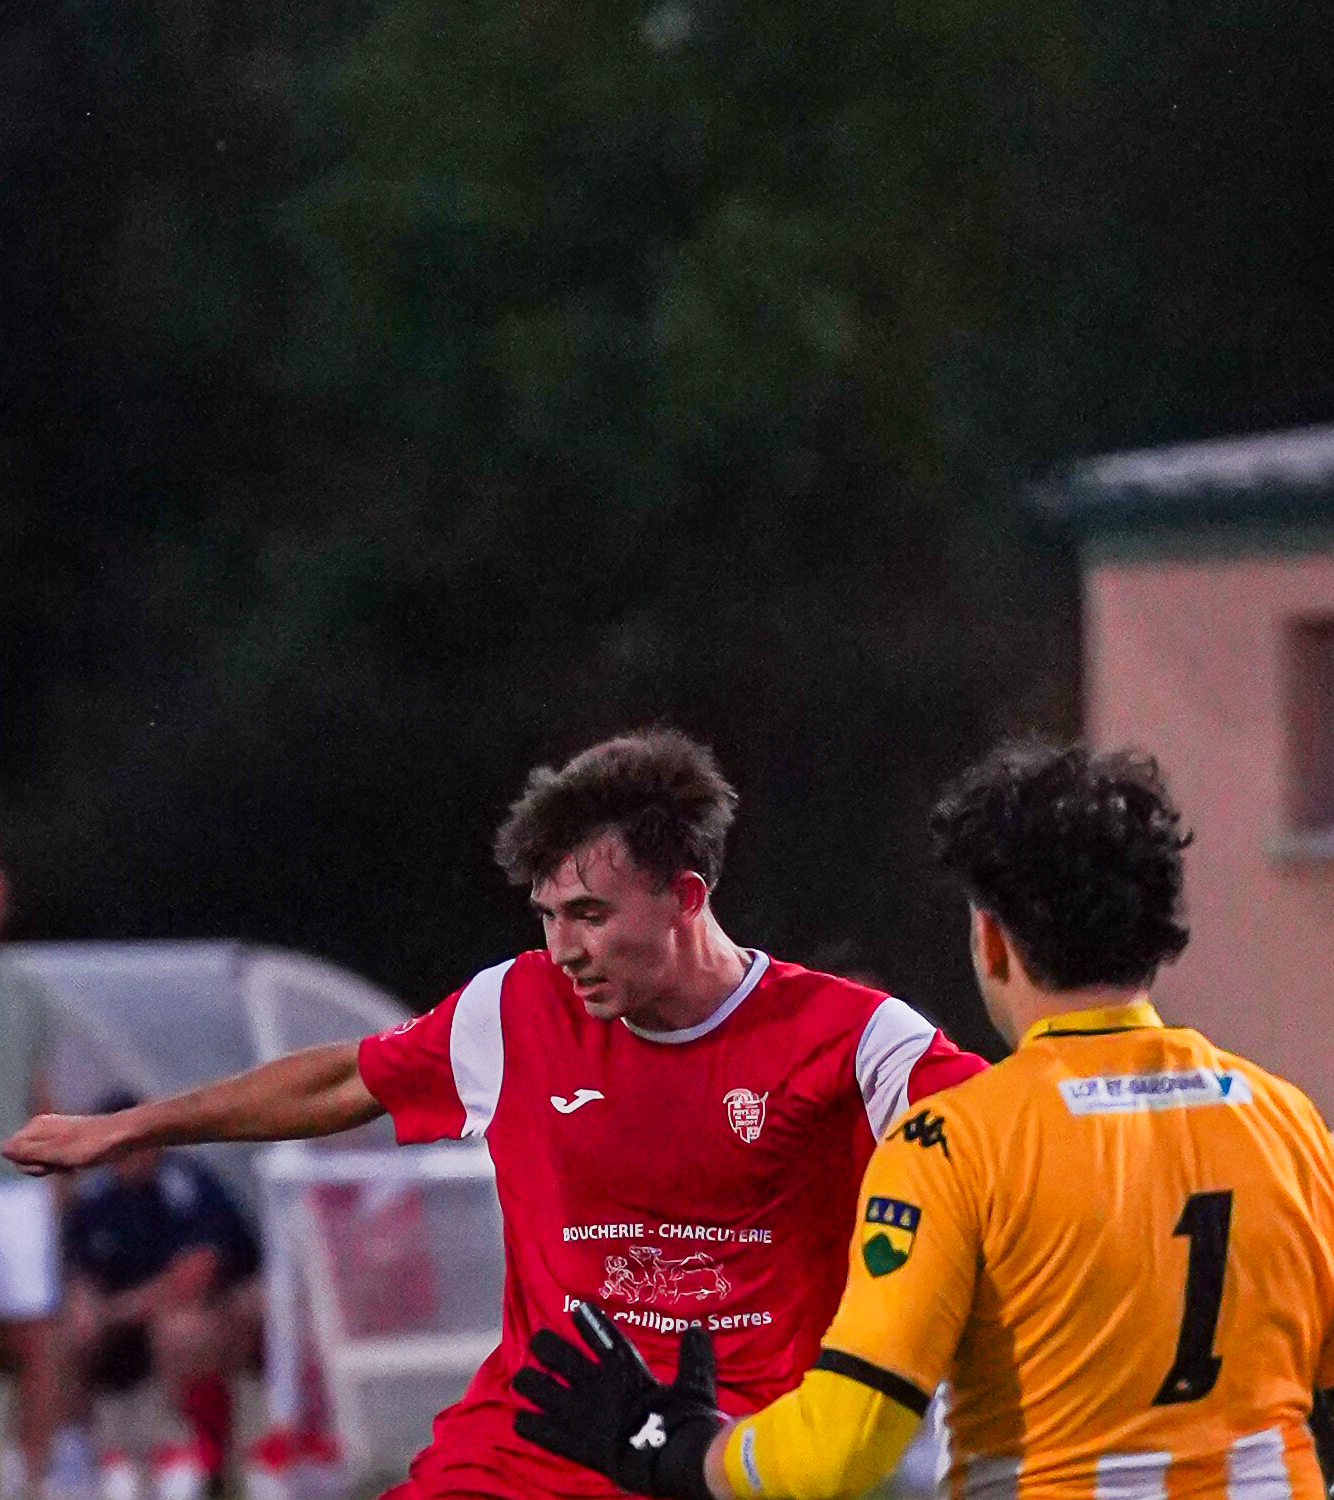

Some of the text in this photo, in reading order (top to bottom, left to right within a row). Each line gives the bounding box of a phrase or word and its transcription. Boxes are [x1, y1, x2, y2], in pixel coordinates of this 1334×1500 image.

[563, 1223, 644, 1242] BOUCHERIE
[658, 1223, 773, 1244] CHARCUTERIE
[1152, 1189, 1233, 1407] 1
[708, 1311, 772, 1331] Serres
